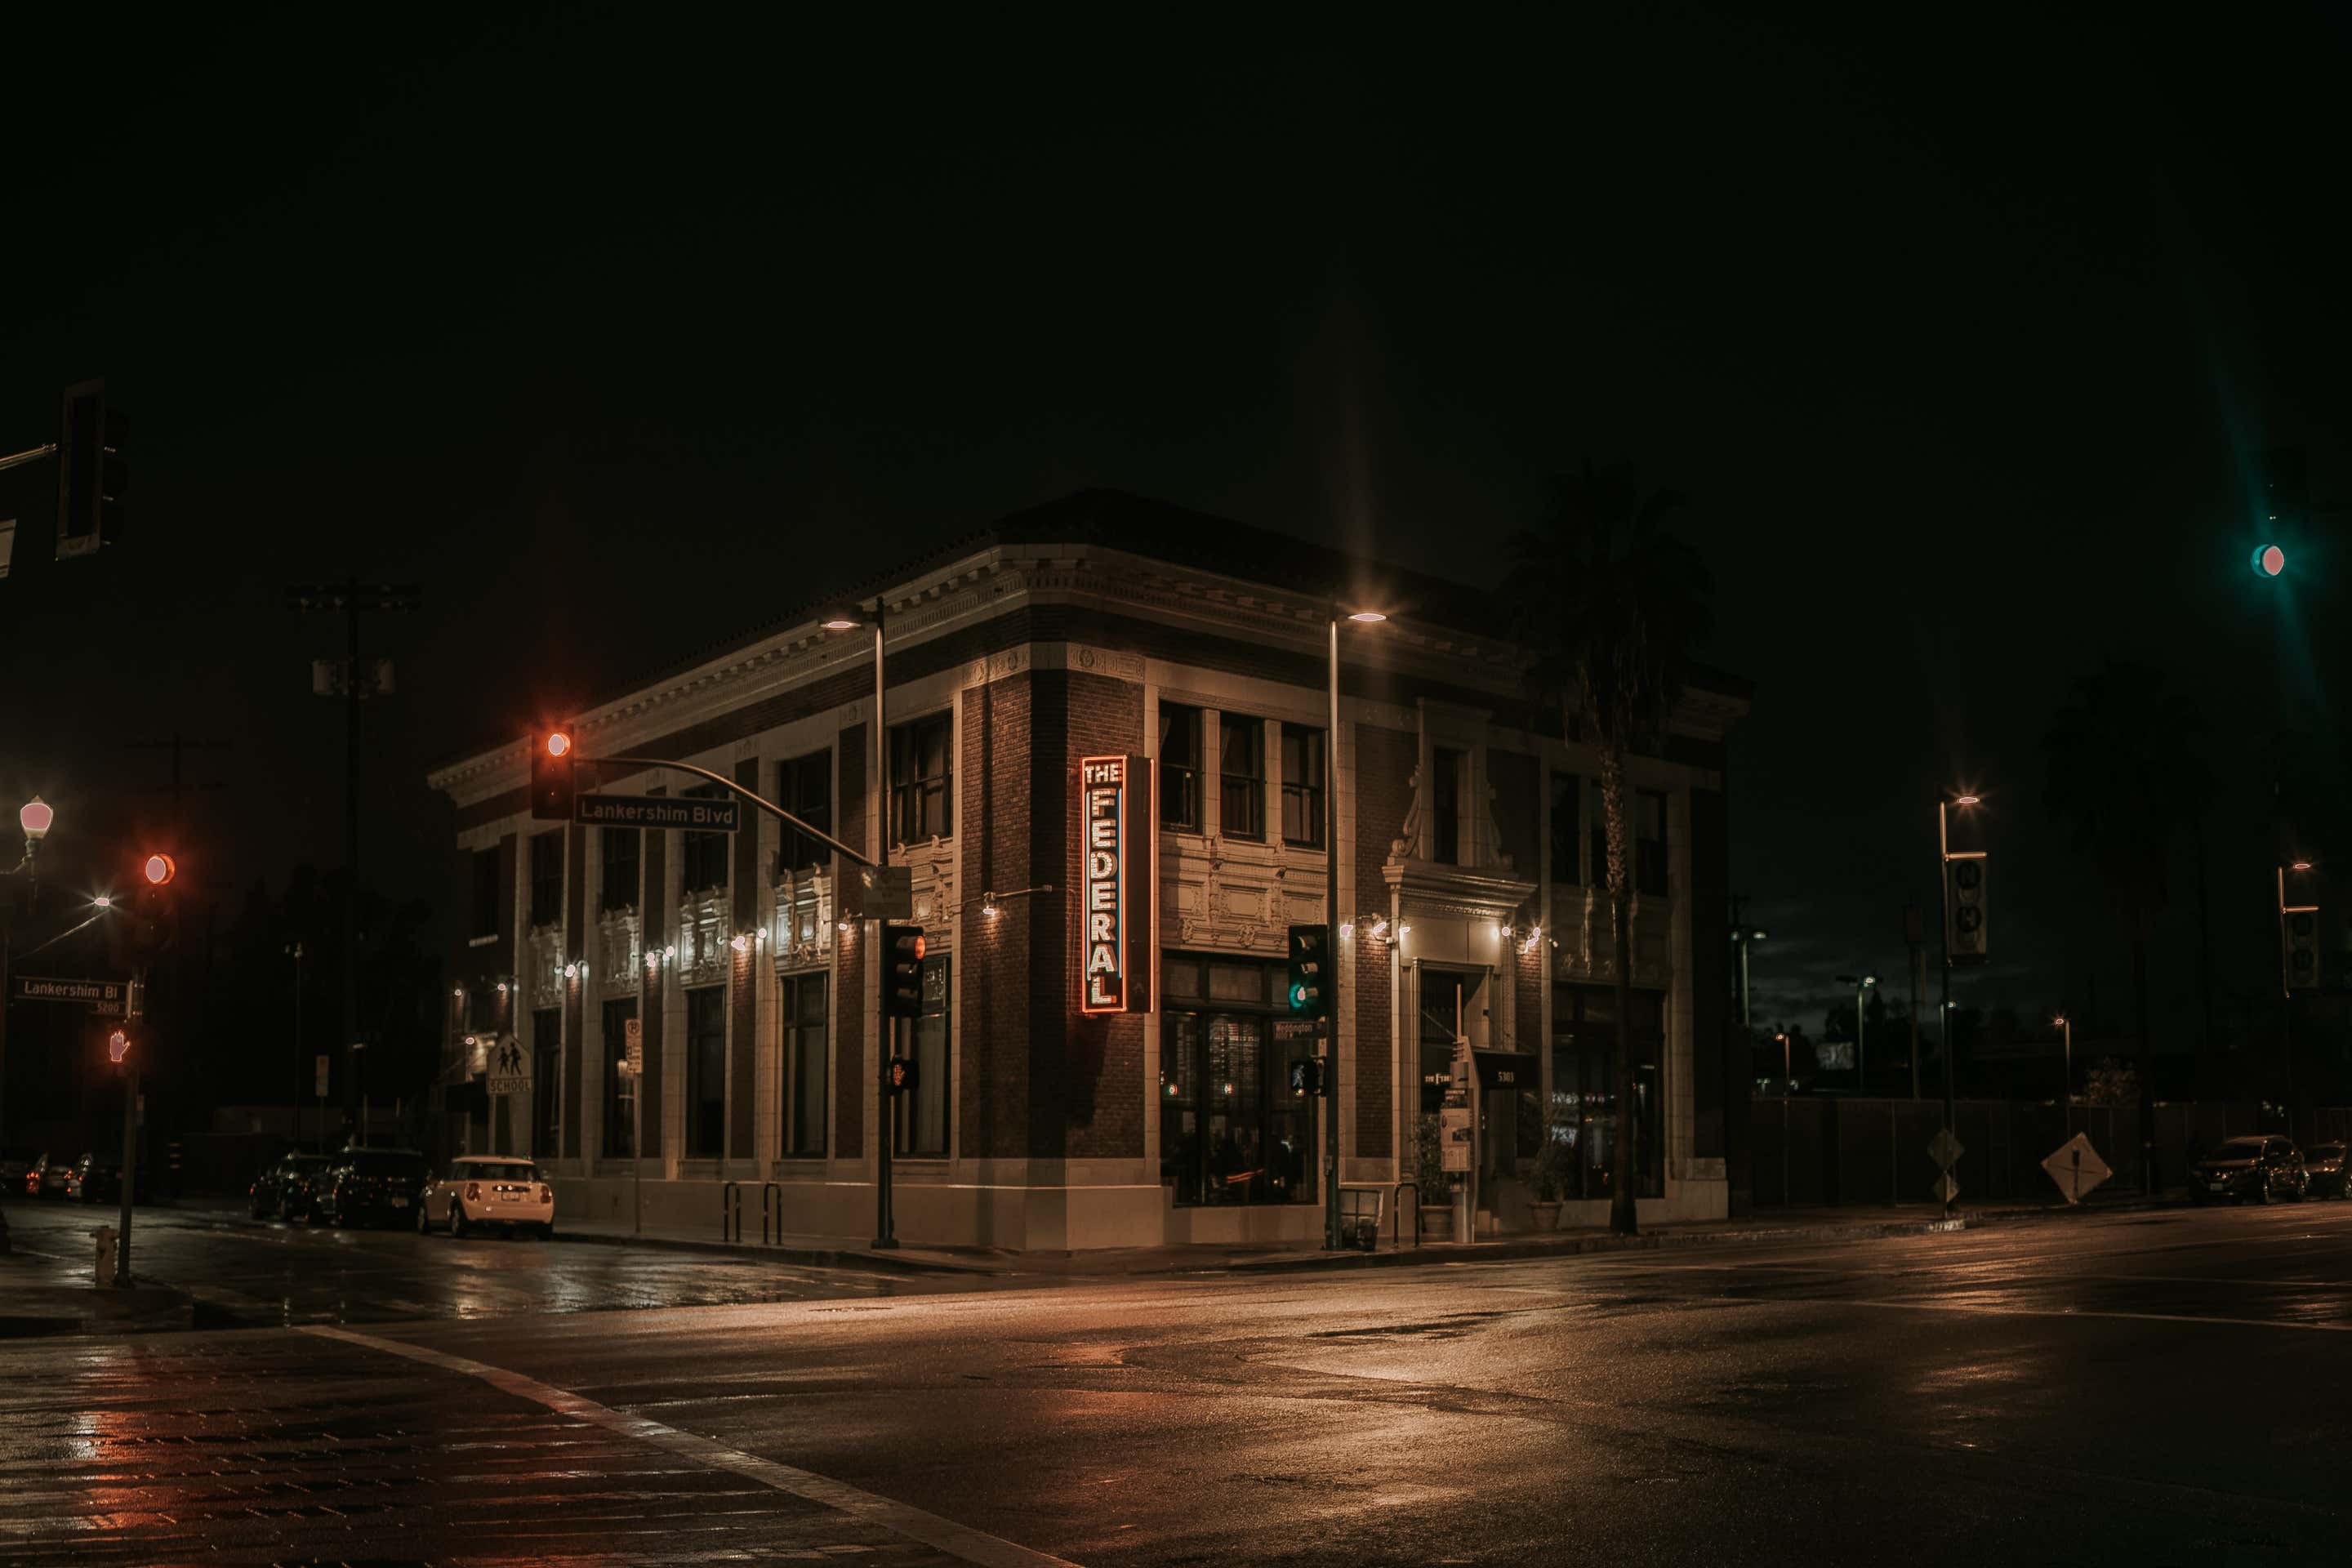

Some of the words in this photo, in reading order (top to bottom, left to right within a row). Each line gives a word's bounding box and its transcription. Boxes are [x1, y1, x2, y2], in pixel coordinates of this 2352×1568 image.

[1085, 763, 1123, 784] THE
[581, 799, 688, 822] Lankershim
[693, 806, 733, 824] Blvd
[1089, 787, 1118, 1005] FEDERAL
[24, 980, 100, 998] Lankershim
[105, 986, 118, 1000] Bl
[489, 1079, 531, 1092] SCHOOL
